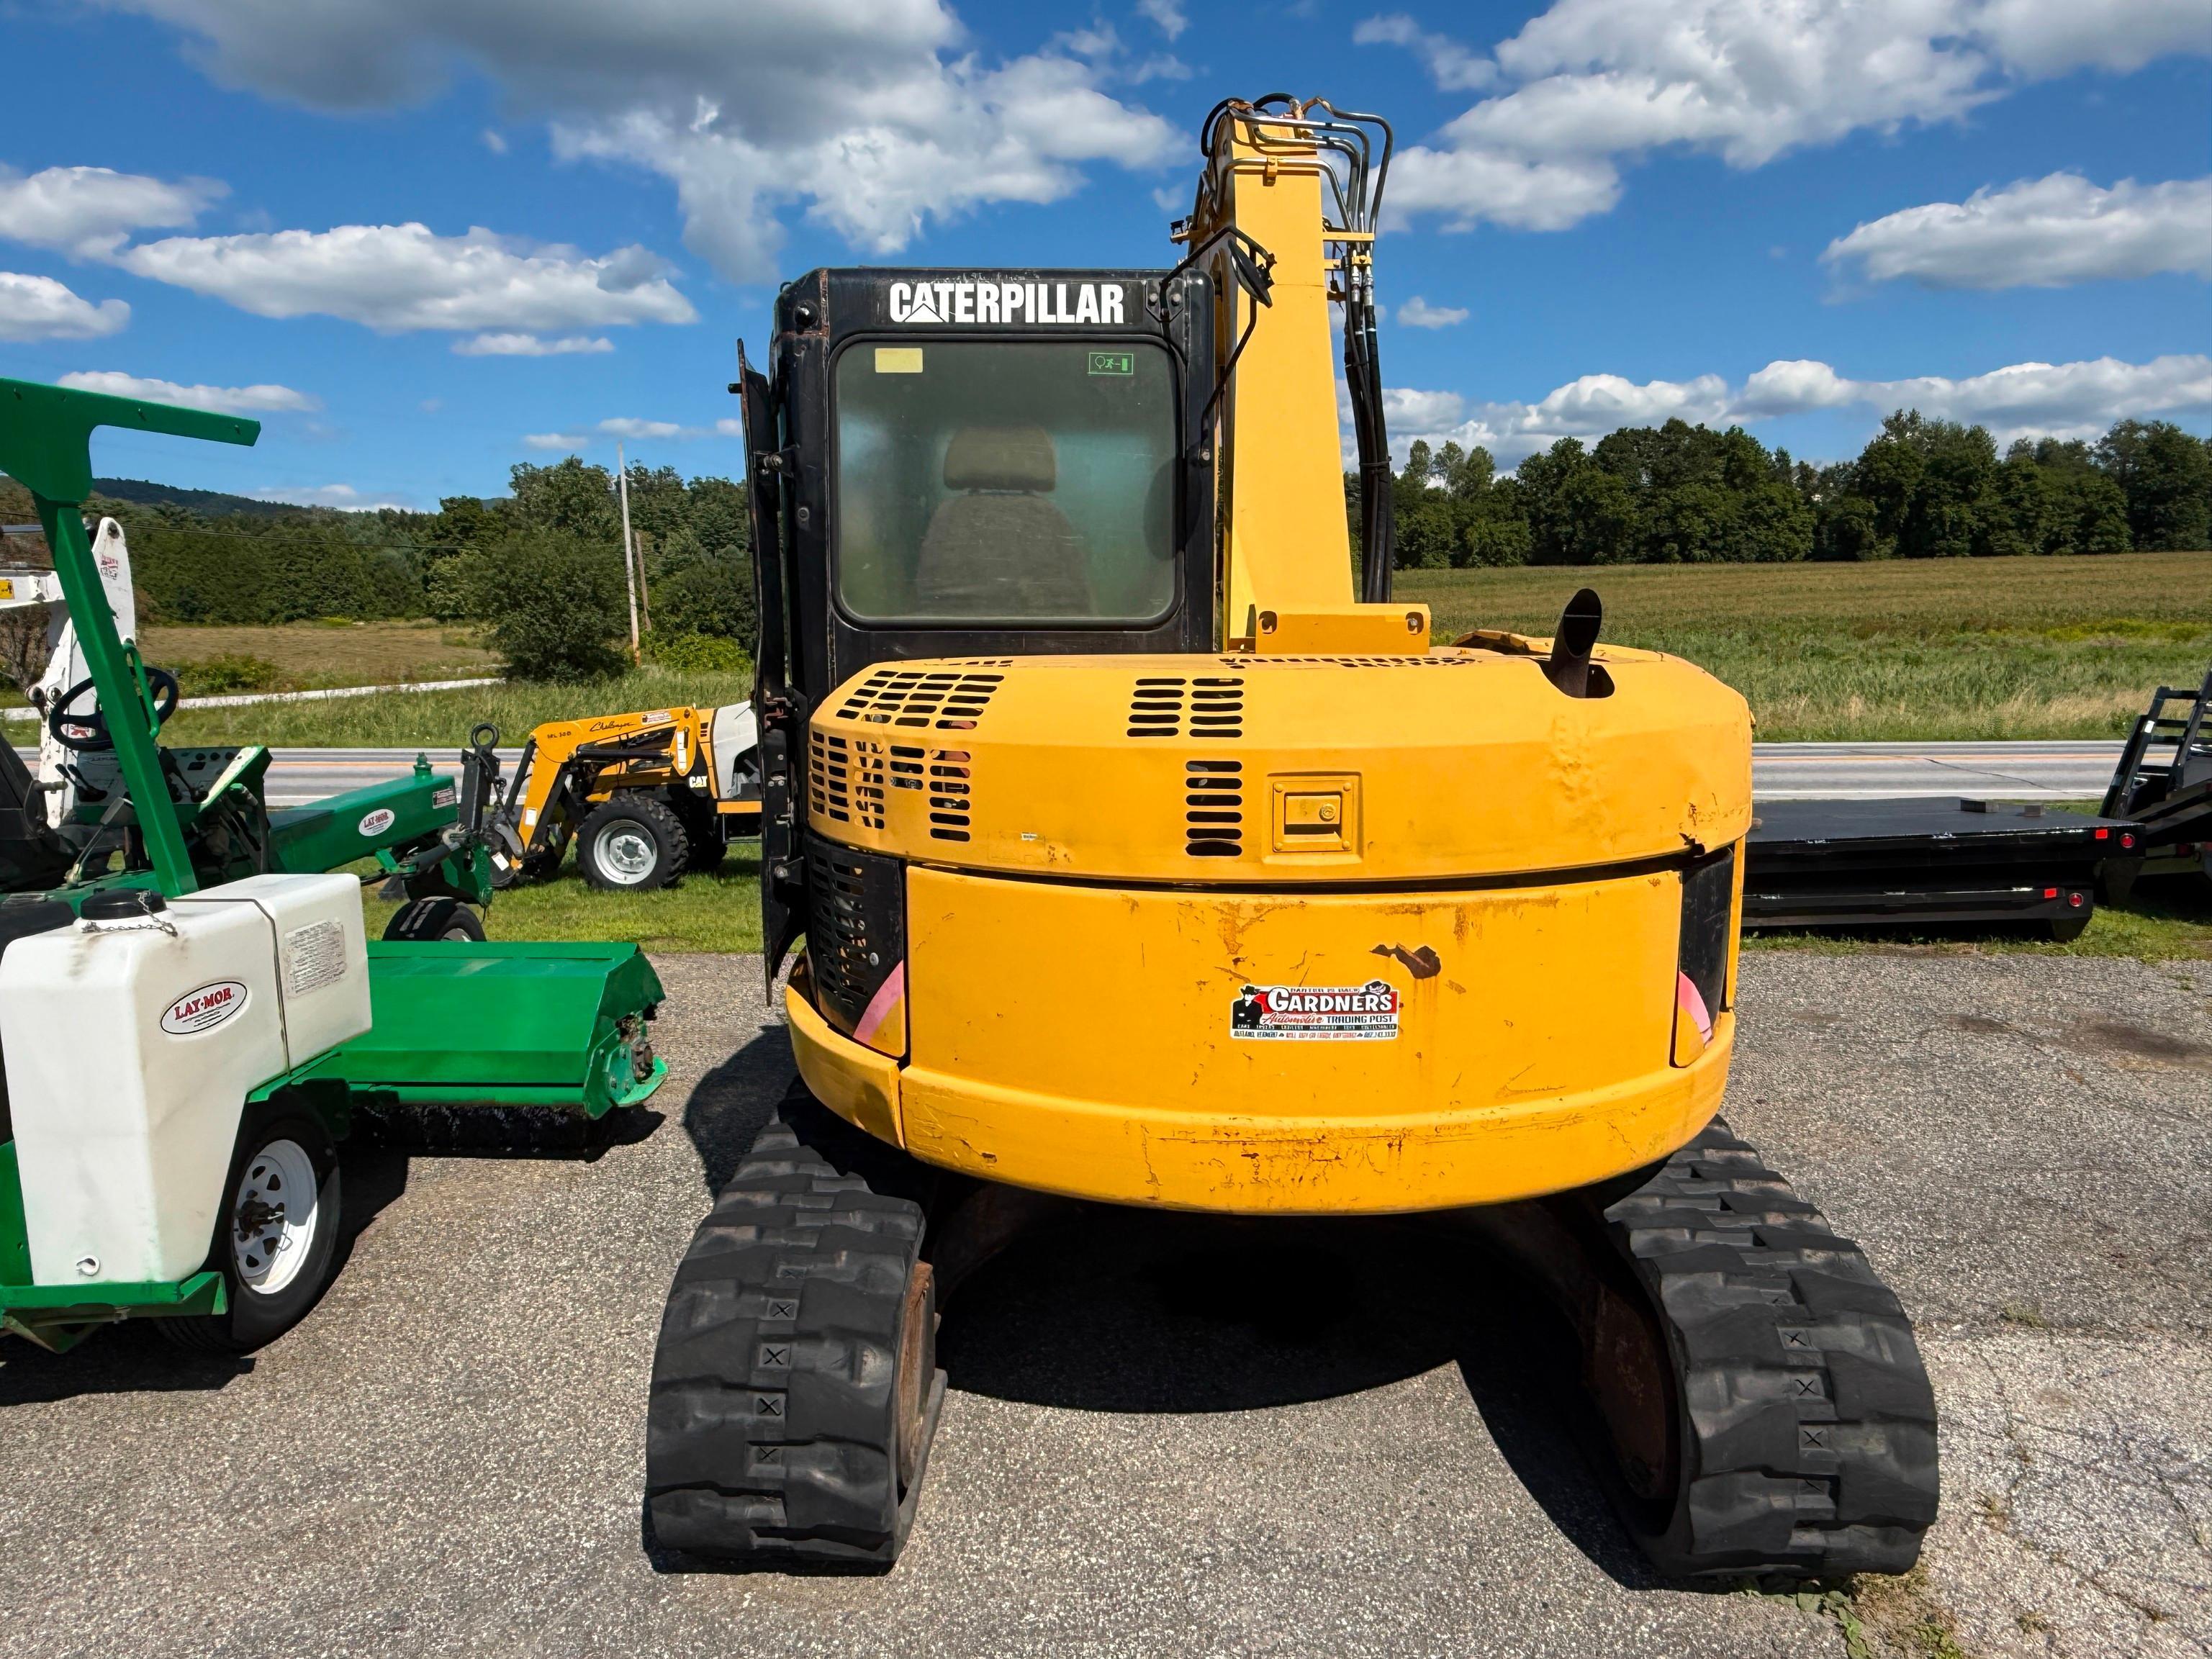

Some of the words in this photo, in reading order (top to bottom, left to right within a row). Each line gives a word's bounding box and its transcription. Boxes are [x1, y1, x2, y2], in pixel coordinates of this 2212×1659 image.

[890, 282, 1124, 323] CATERPILLAR
[689, 776, 708, 788] CAT
[1262, 1012, 1323, 1024] Automotive
